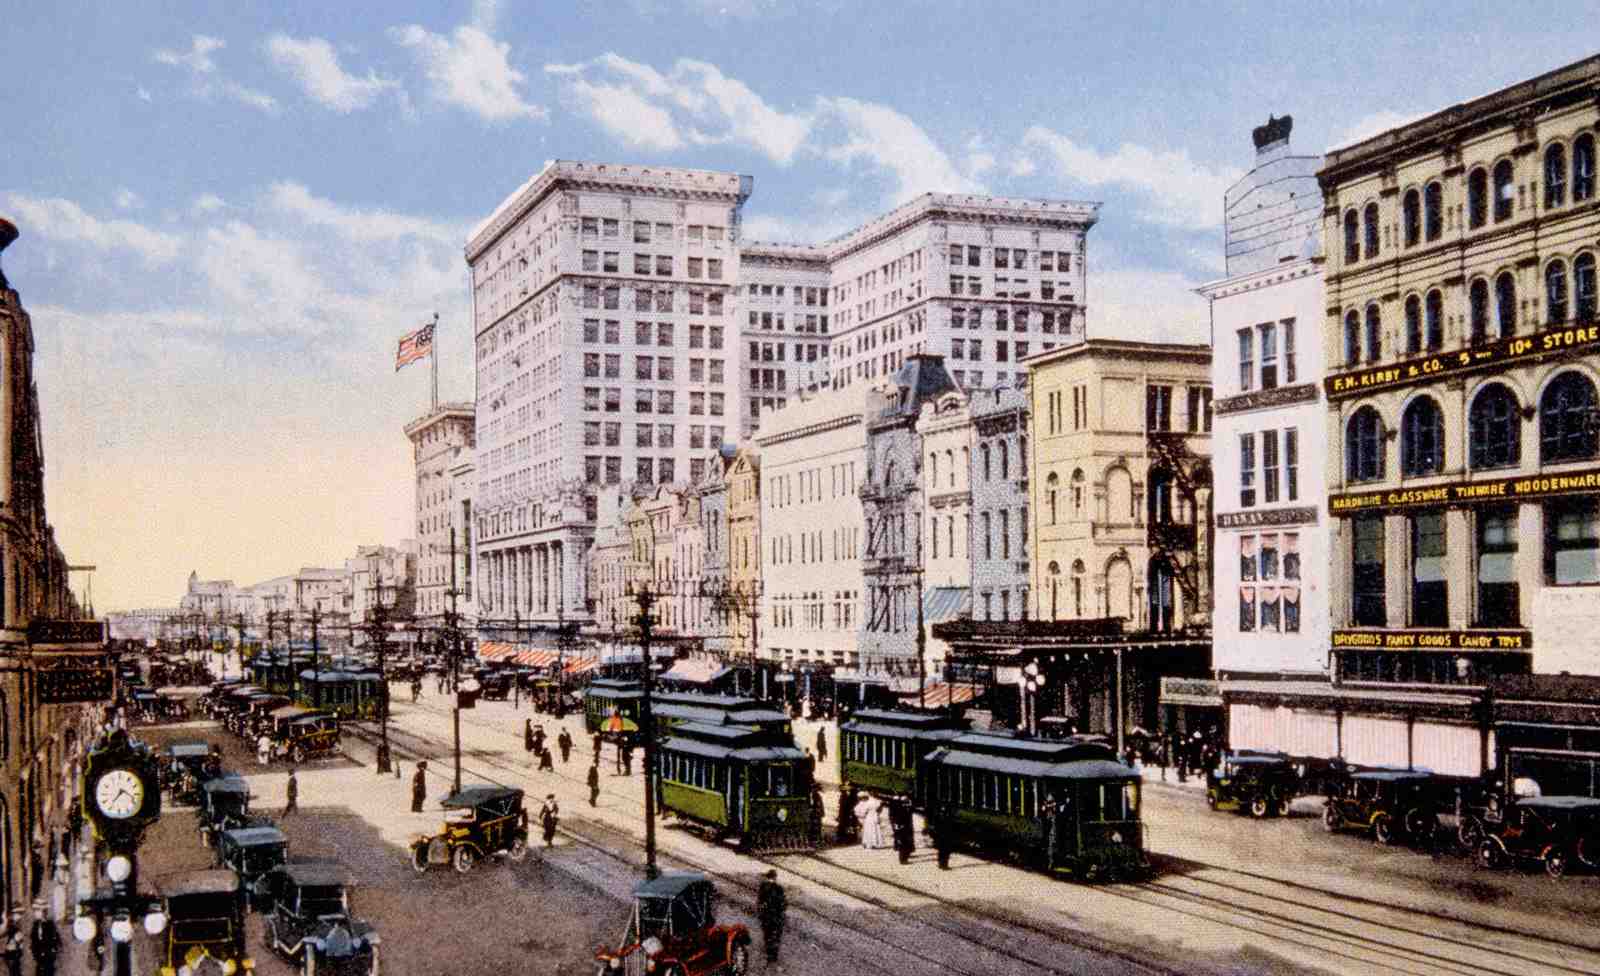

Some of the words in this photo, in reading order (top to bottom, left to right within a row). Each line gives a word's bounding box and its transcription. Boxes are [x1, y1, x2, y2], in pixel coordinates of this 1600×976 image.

[1361, 369, 1400, 386] KIRBY
[1408, 366, 1419, 377] &
[1422, 359, 1444, 374] CO.
[1460, 352, 1470, 366] 5
[1388, 488, 1449, 504] GLASSWARE
[1456, 483, 1506, 497] TINWARE
[1419, 634, 1451, 646] GOODS
[1498, 636, 1522, 648] TOYS
